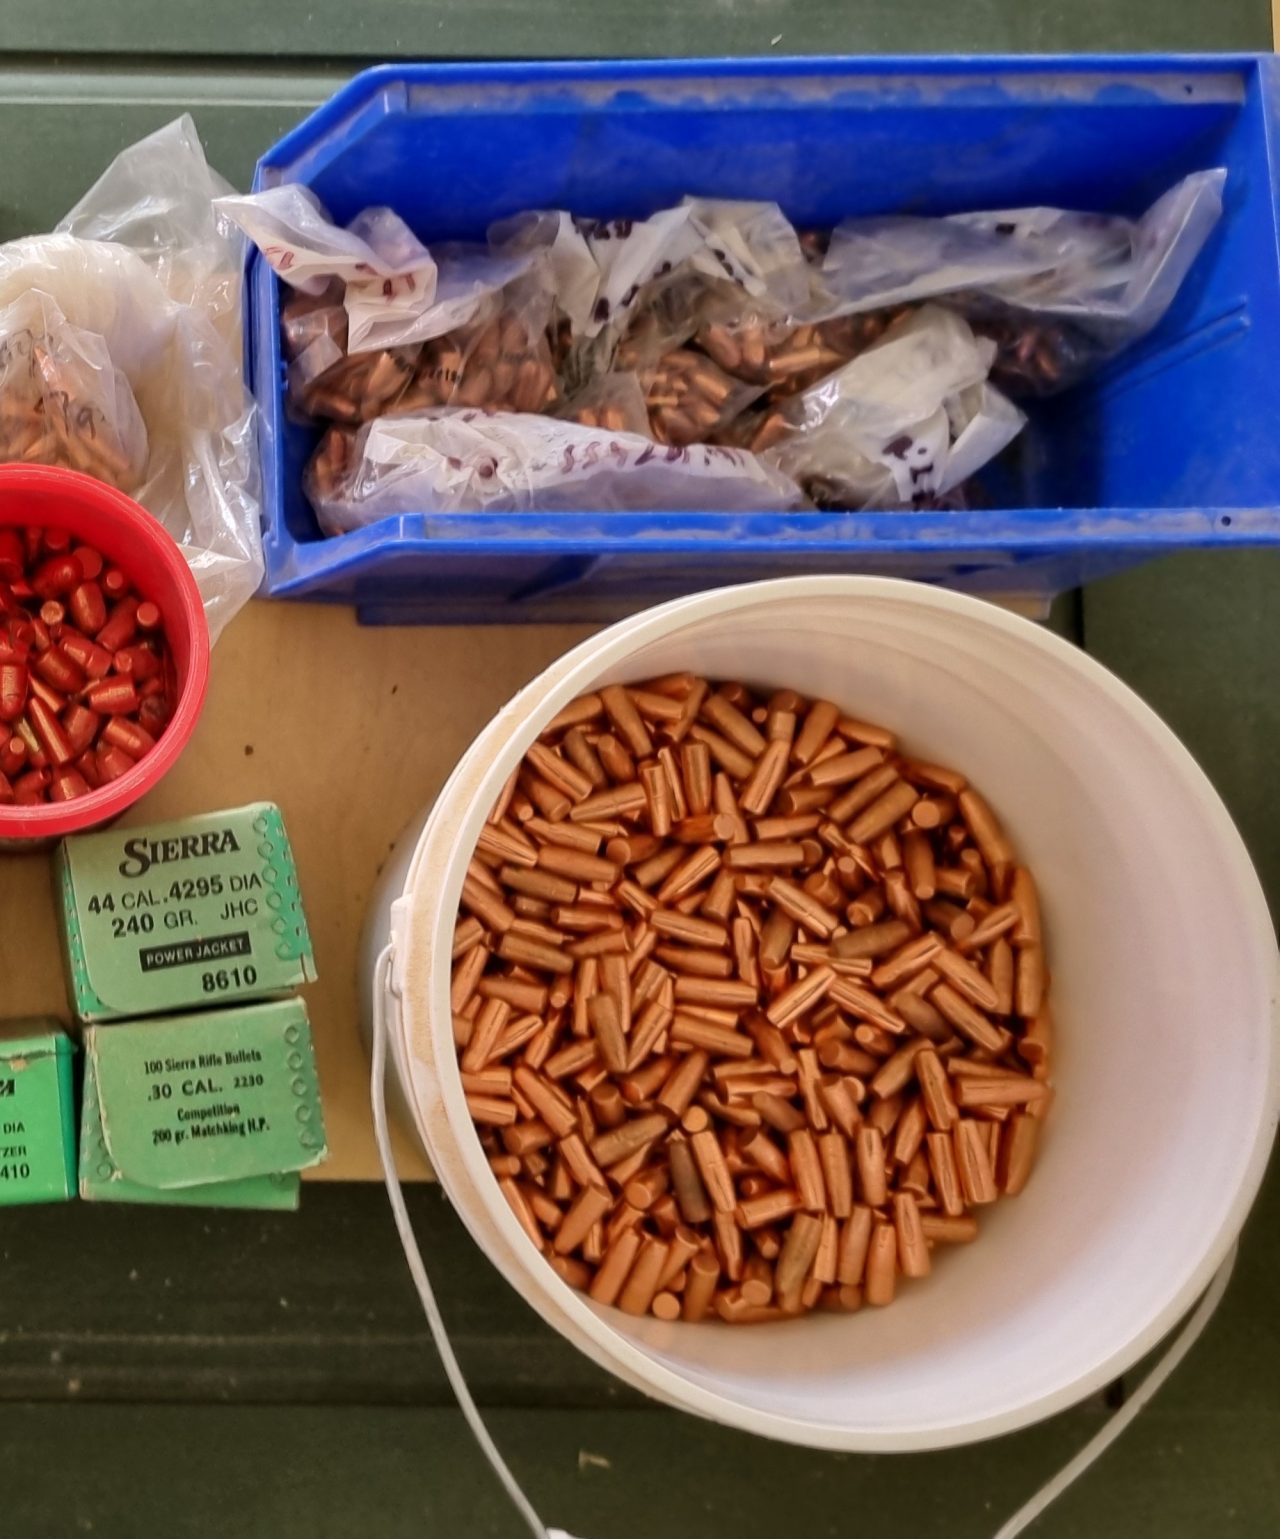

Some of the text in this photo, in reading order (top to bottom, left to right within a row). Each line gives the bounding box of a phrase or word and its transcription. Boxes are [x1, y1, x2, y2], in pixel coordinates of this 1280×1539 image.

[88, 892, 115, 914] 44
[229, 872, 263, 892] DIA
[111, 898, 259, 939] 240 GR. JHC
[146, 938, 244, 967] POWER JACKET
[201, 964, 258, 993] 8610
[144, 1048, 262, 1075] 100 Sierra Rifle Bullets
[147, 1083, 172, 1101] .30
[181, 1078, 223, 1097] CAL.
[177, 1102, 240, 1122] Competition
[3, 1121, 25, 1135] DIA
[191, 1120, 246, 1138] Matchking
